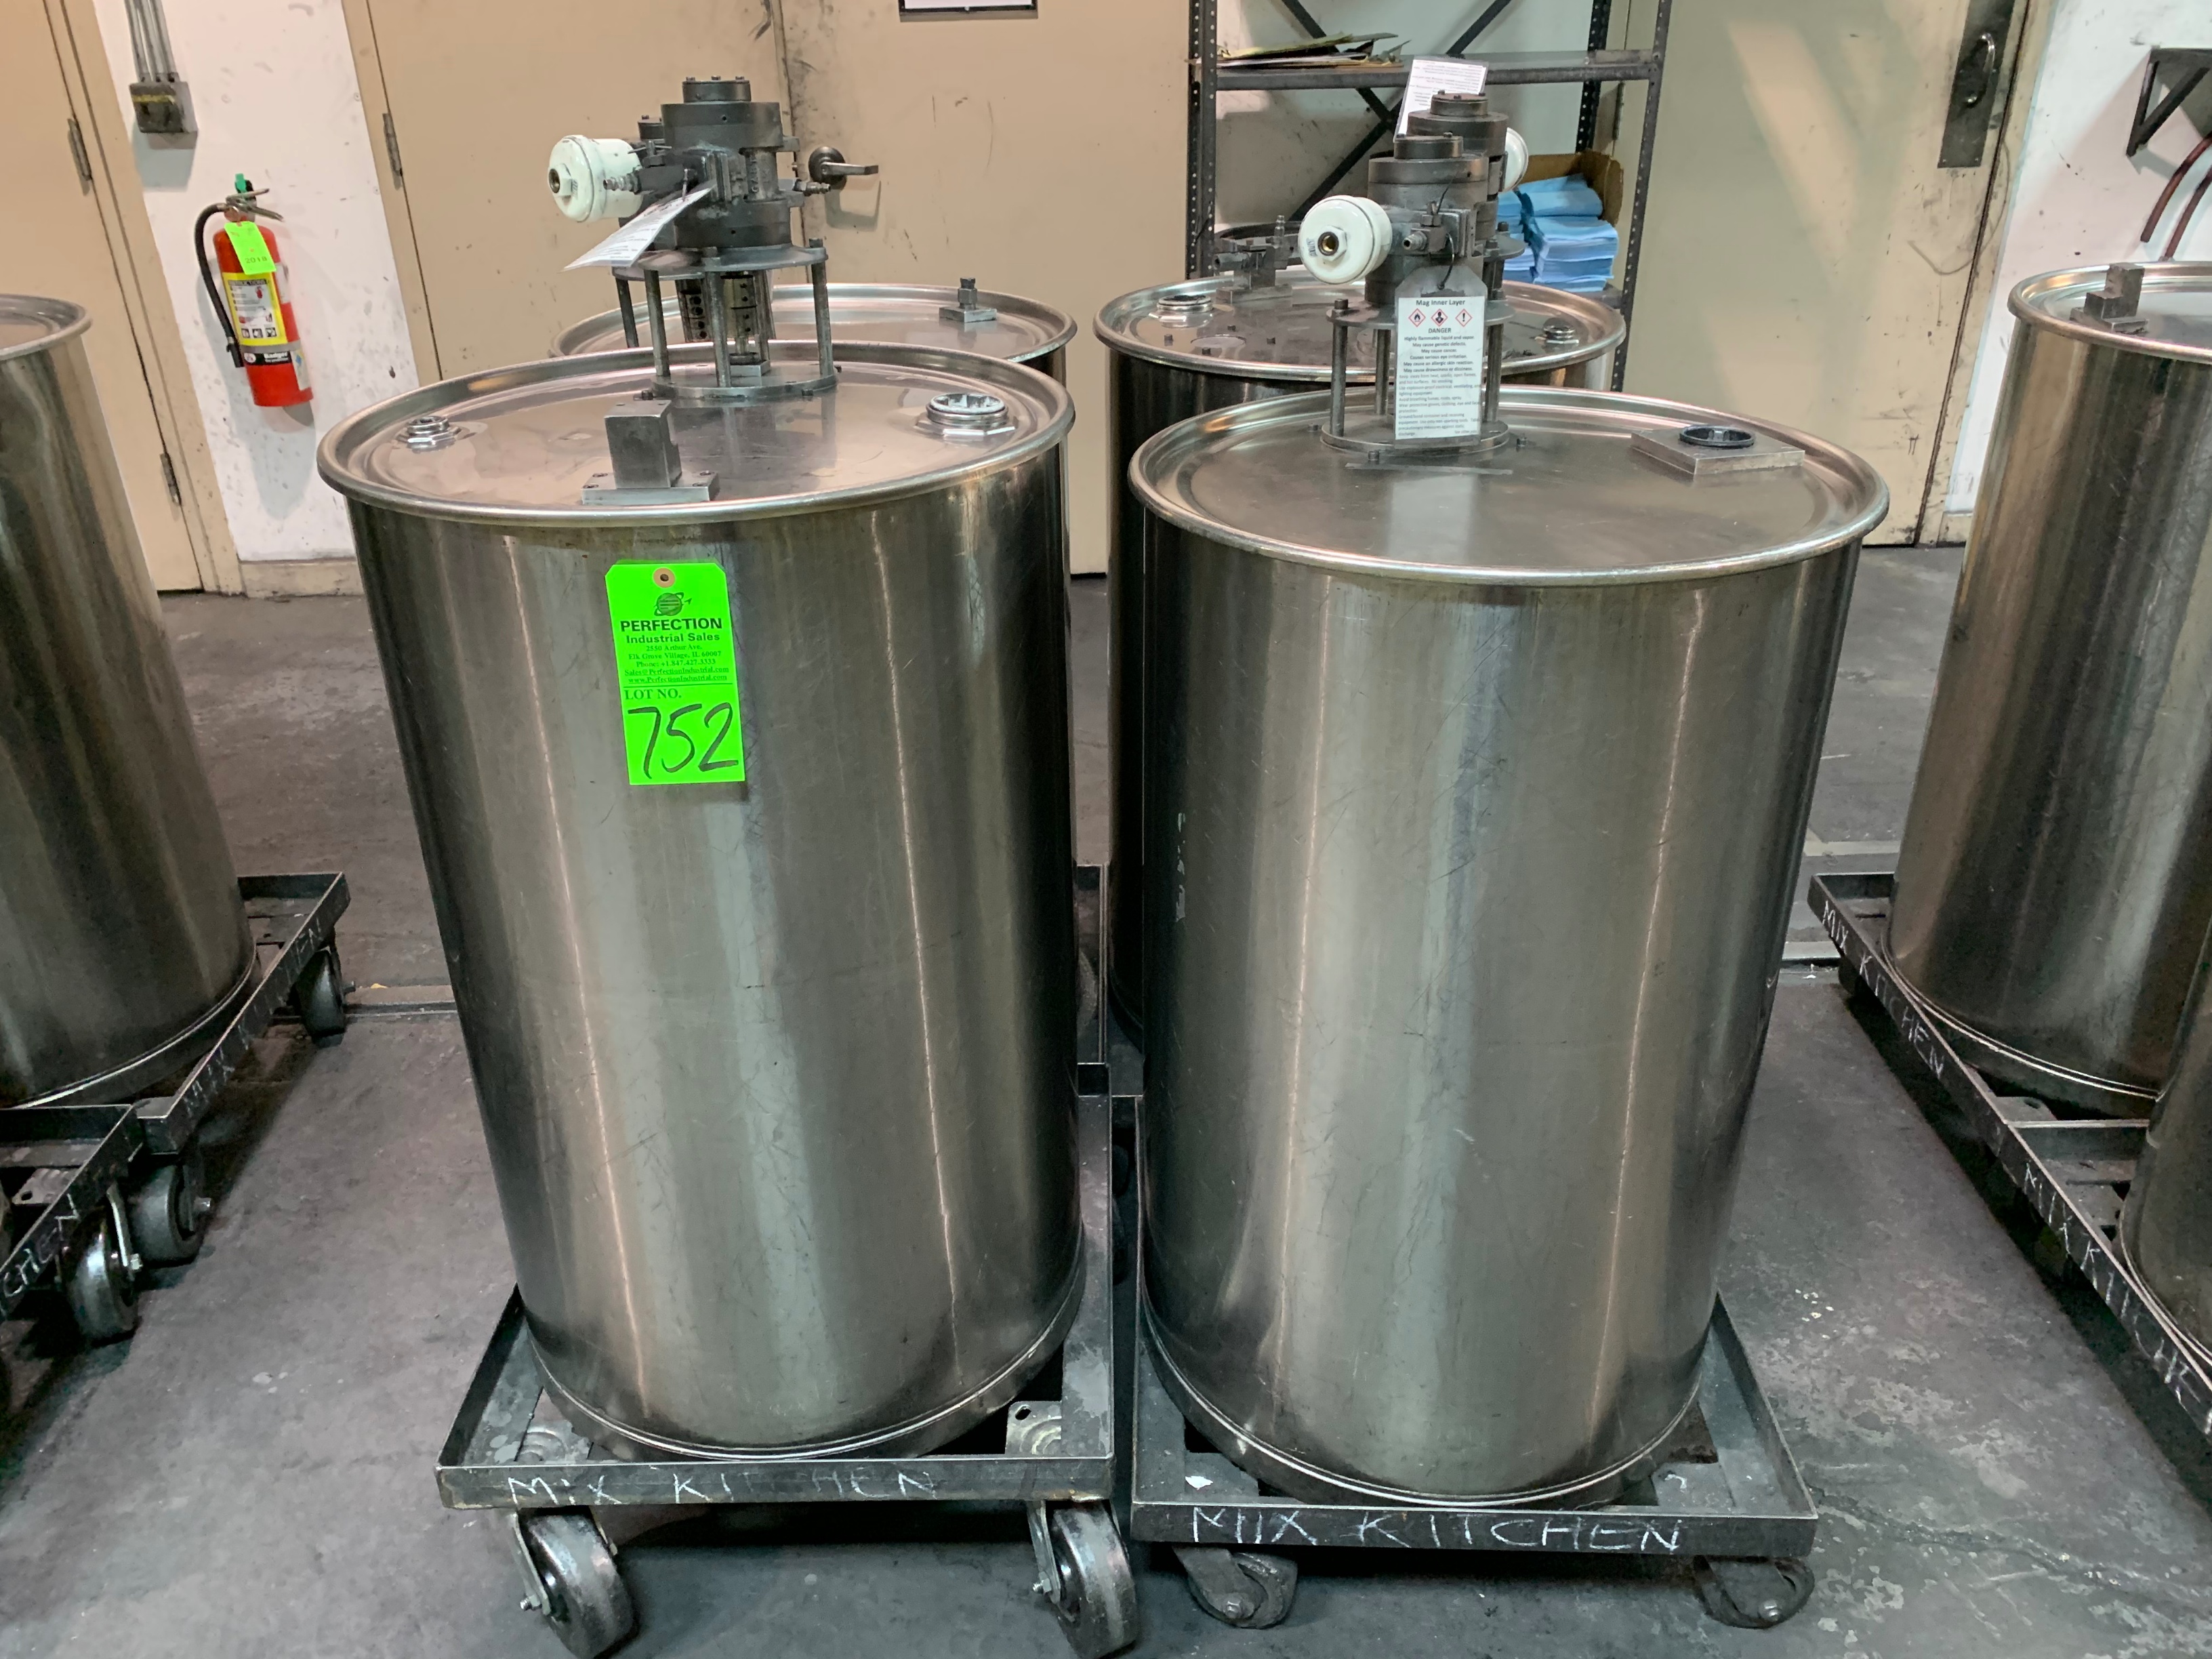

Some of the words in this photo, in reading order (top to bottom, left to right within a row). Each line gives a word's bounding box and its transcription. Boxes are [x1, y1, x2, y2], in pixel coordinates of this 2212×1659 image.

[621, 618, 722, 632] PERFECTION
[626, 634, 683, 643] Industrial
[625, 689, 653, 700] LOT
[657, 687, 682, 699] NO.
[628, 702, 739, 779] 752
[1193, 1507, 1317, 1546] MIX
[1355, 1511, 1681, 1555] KITCHEN
